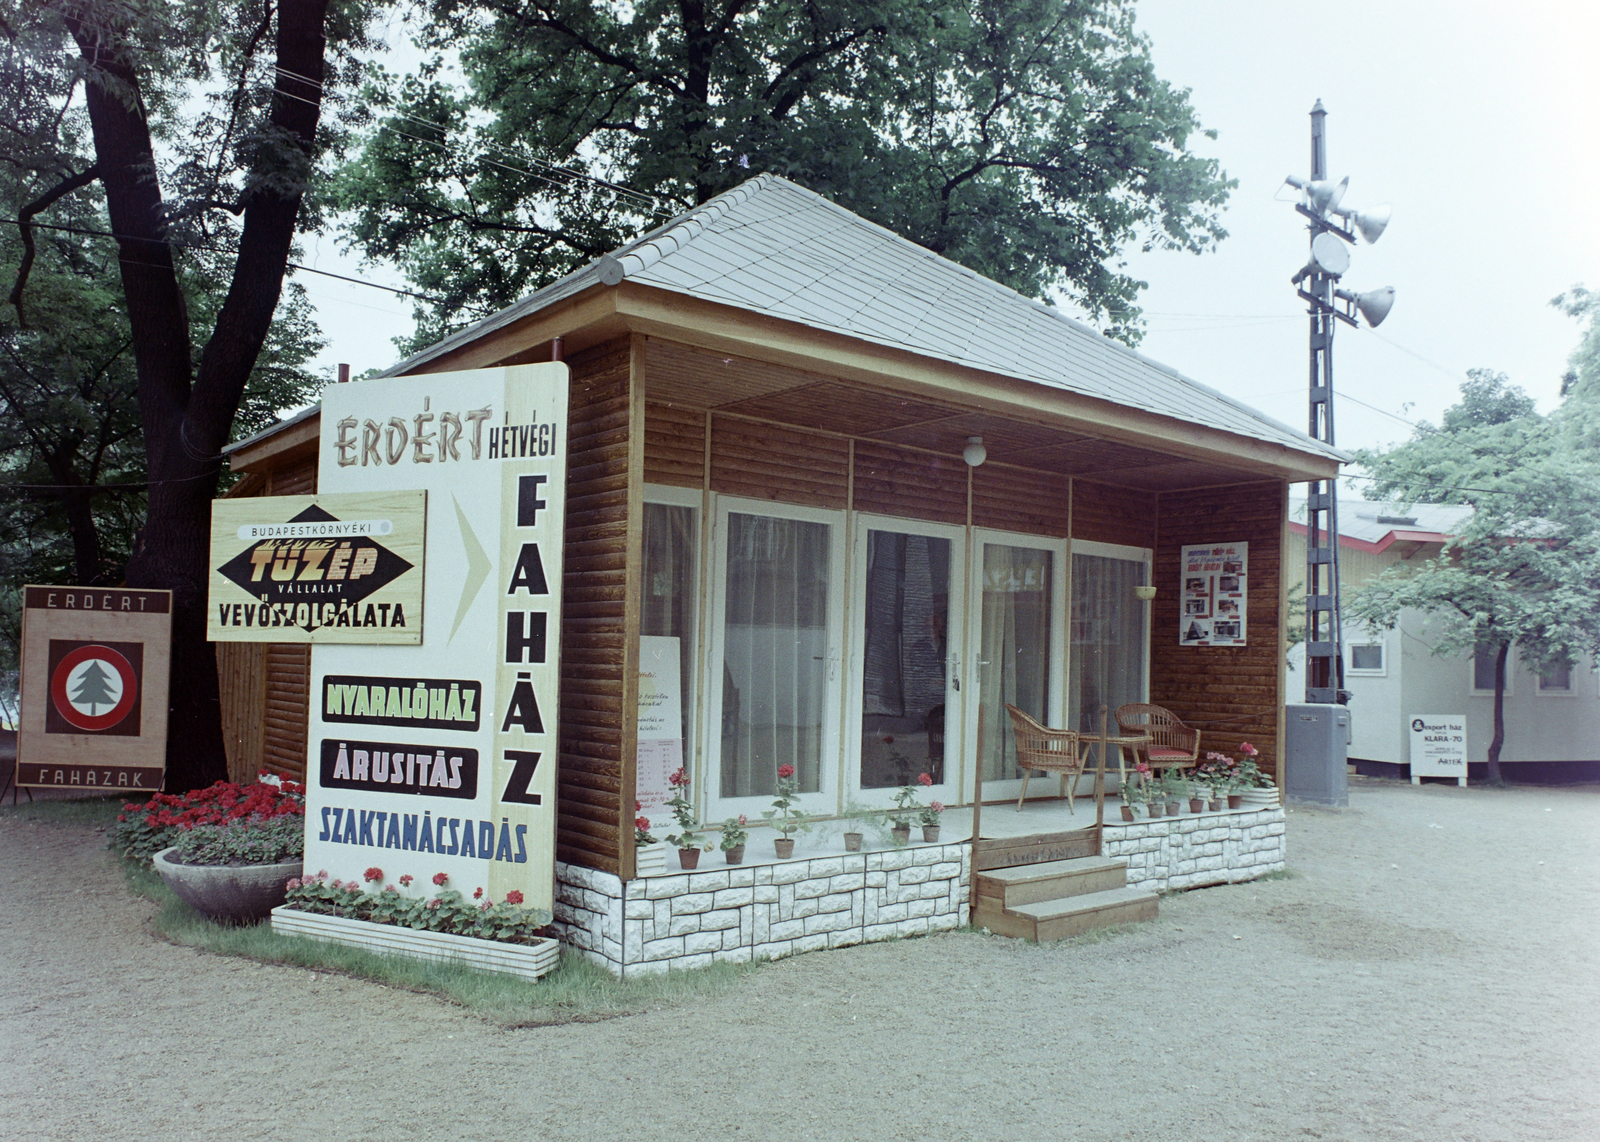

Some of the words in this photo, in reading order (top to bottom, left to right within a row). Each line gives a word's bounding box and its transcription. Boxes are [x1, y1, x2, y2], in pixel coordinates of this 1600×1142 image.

[333, 395, 492, 467] ERDÉRT
[488, 410, 557, 459] HÉTVÉGI
[251, 523, 371, 537] BUDAPESTKÖRNYÉKI
[47, 593, 147, 611] ERDÉRT
[278, 583, 343, 594] VÁLLALAT
[501, 475, 549, 806] FAHÁZ
[326, 682, 476, 722] NYARALÓHÁZ
[1424, 724, 1447, 732] export
[39, 769, 143, 787] FAHÁZAK
[333, 743, 463, 789] ÁRUSITÁS
[319, 806, 528, 864] SZAKTANÁCSADÁS
